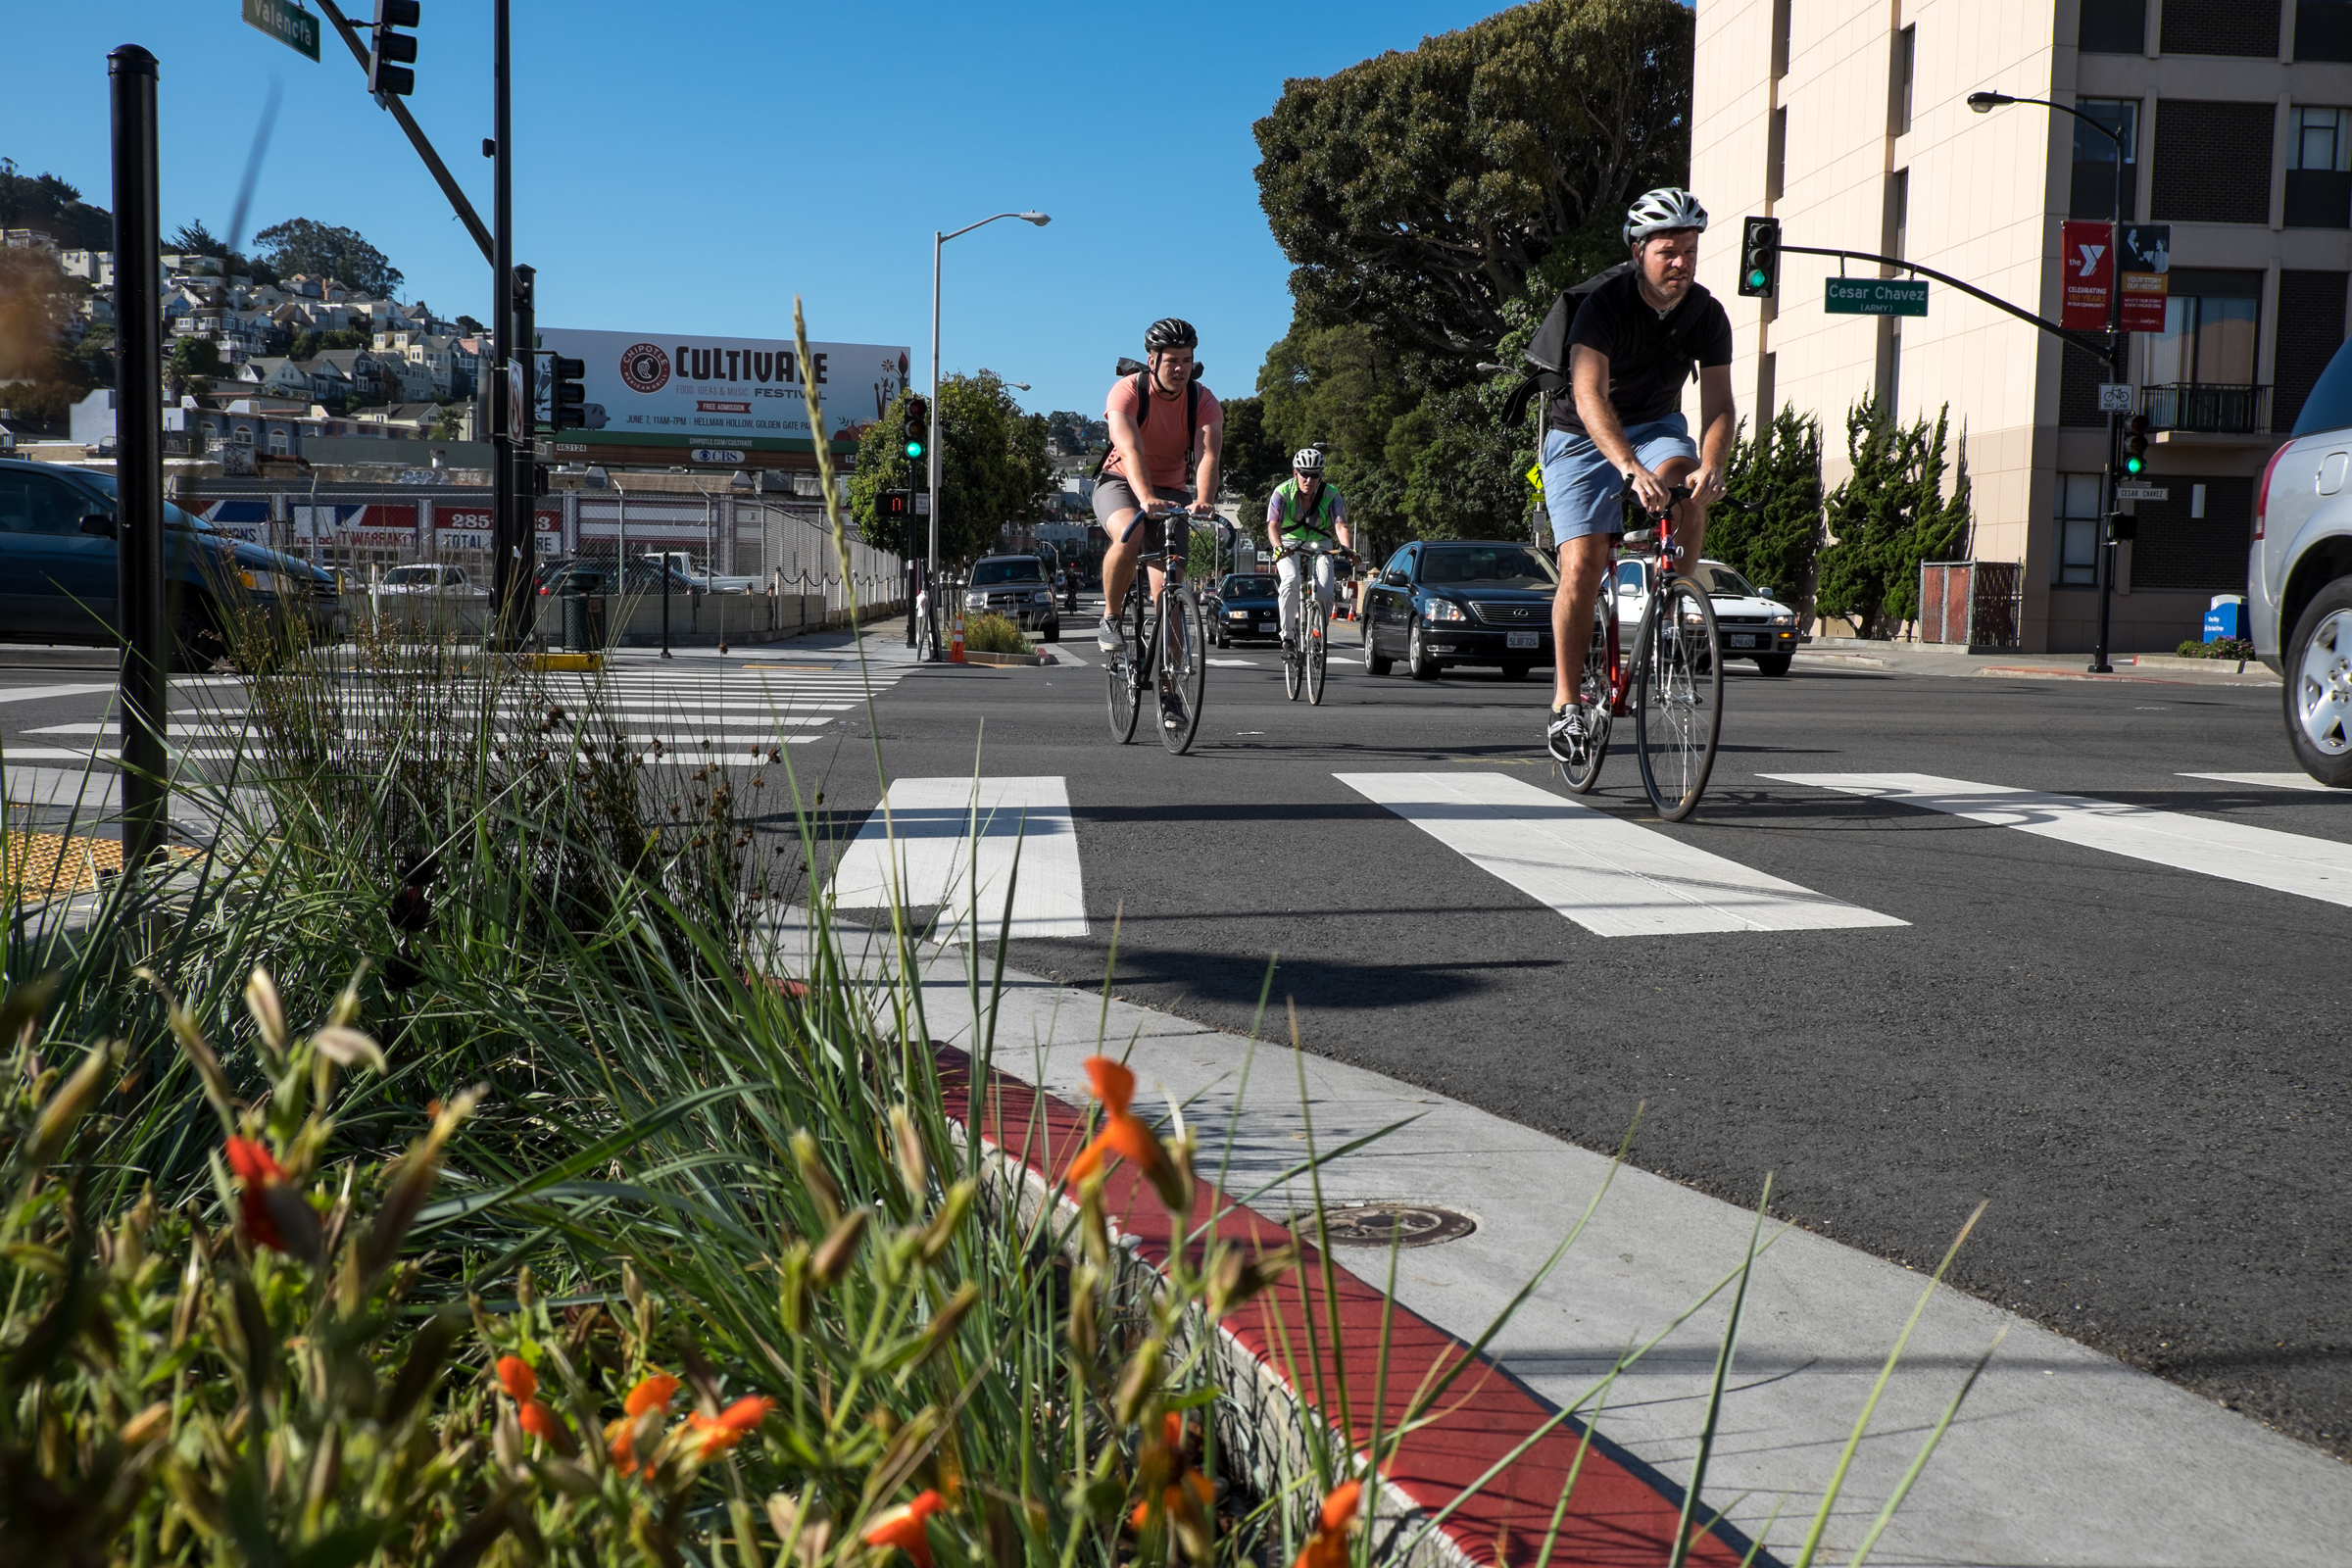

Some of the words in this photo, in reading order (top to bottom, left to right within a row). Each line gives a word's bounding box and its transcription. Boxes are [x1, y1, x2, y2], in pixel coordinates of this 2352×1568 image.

[255, 0, 312, 46] Valencia
[1829, 284, 1869, 299] Cesar
[1875, 286, 1925, 301] Chavez
[2082, 294, 2106, 303] YEARS
[1860, 303, 1893, 313] (ARMY)
[623, 345, 668, 366] CHIPOTLE
[624, 371, 651, 390] MEXICAN
[652, 374, 667, 389] GRILL
[676, 385, 696, 395] FOOD,
[698, 386, 717, 395] IDEAS
[727, 388, 749, 397] MUSIC
[755, 388, 827, 400] FESTIVL
[626, 415, 644, 424] JUNE
[653, 416, 687, 425] 11AM-7PM
[694, 416, 724, 427] HELLMAN
[726, 418, 755, 429] HOLLOW,
[756, 419, 781, 429] GOLDEN
[782, 420, 799, 429] GATE
[689, 437, 753, 447] CHIPOTLE.COM/CULTIVATE
[712, 450, 738, 462] CBS
[444, 534, 481, 550] TOTAL
